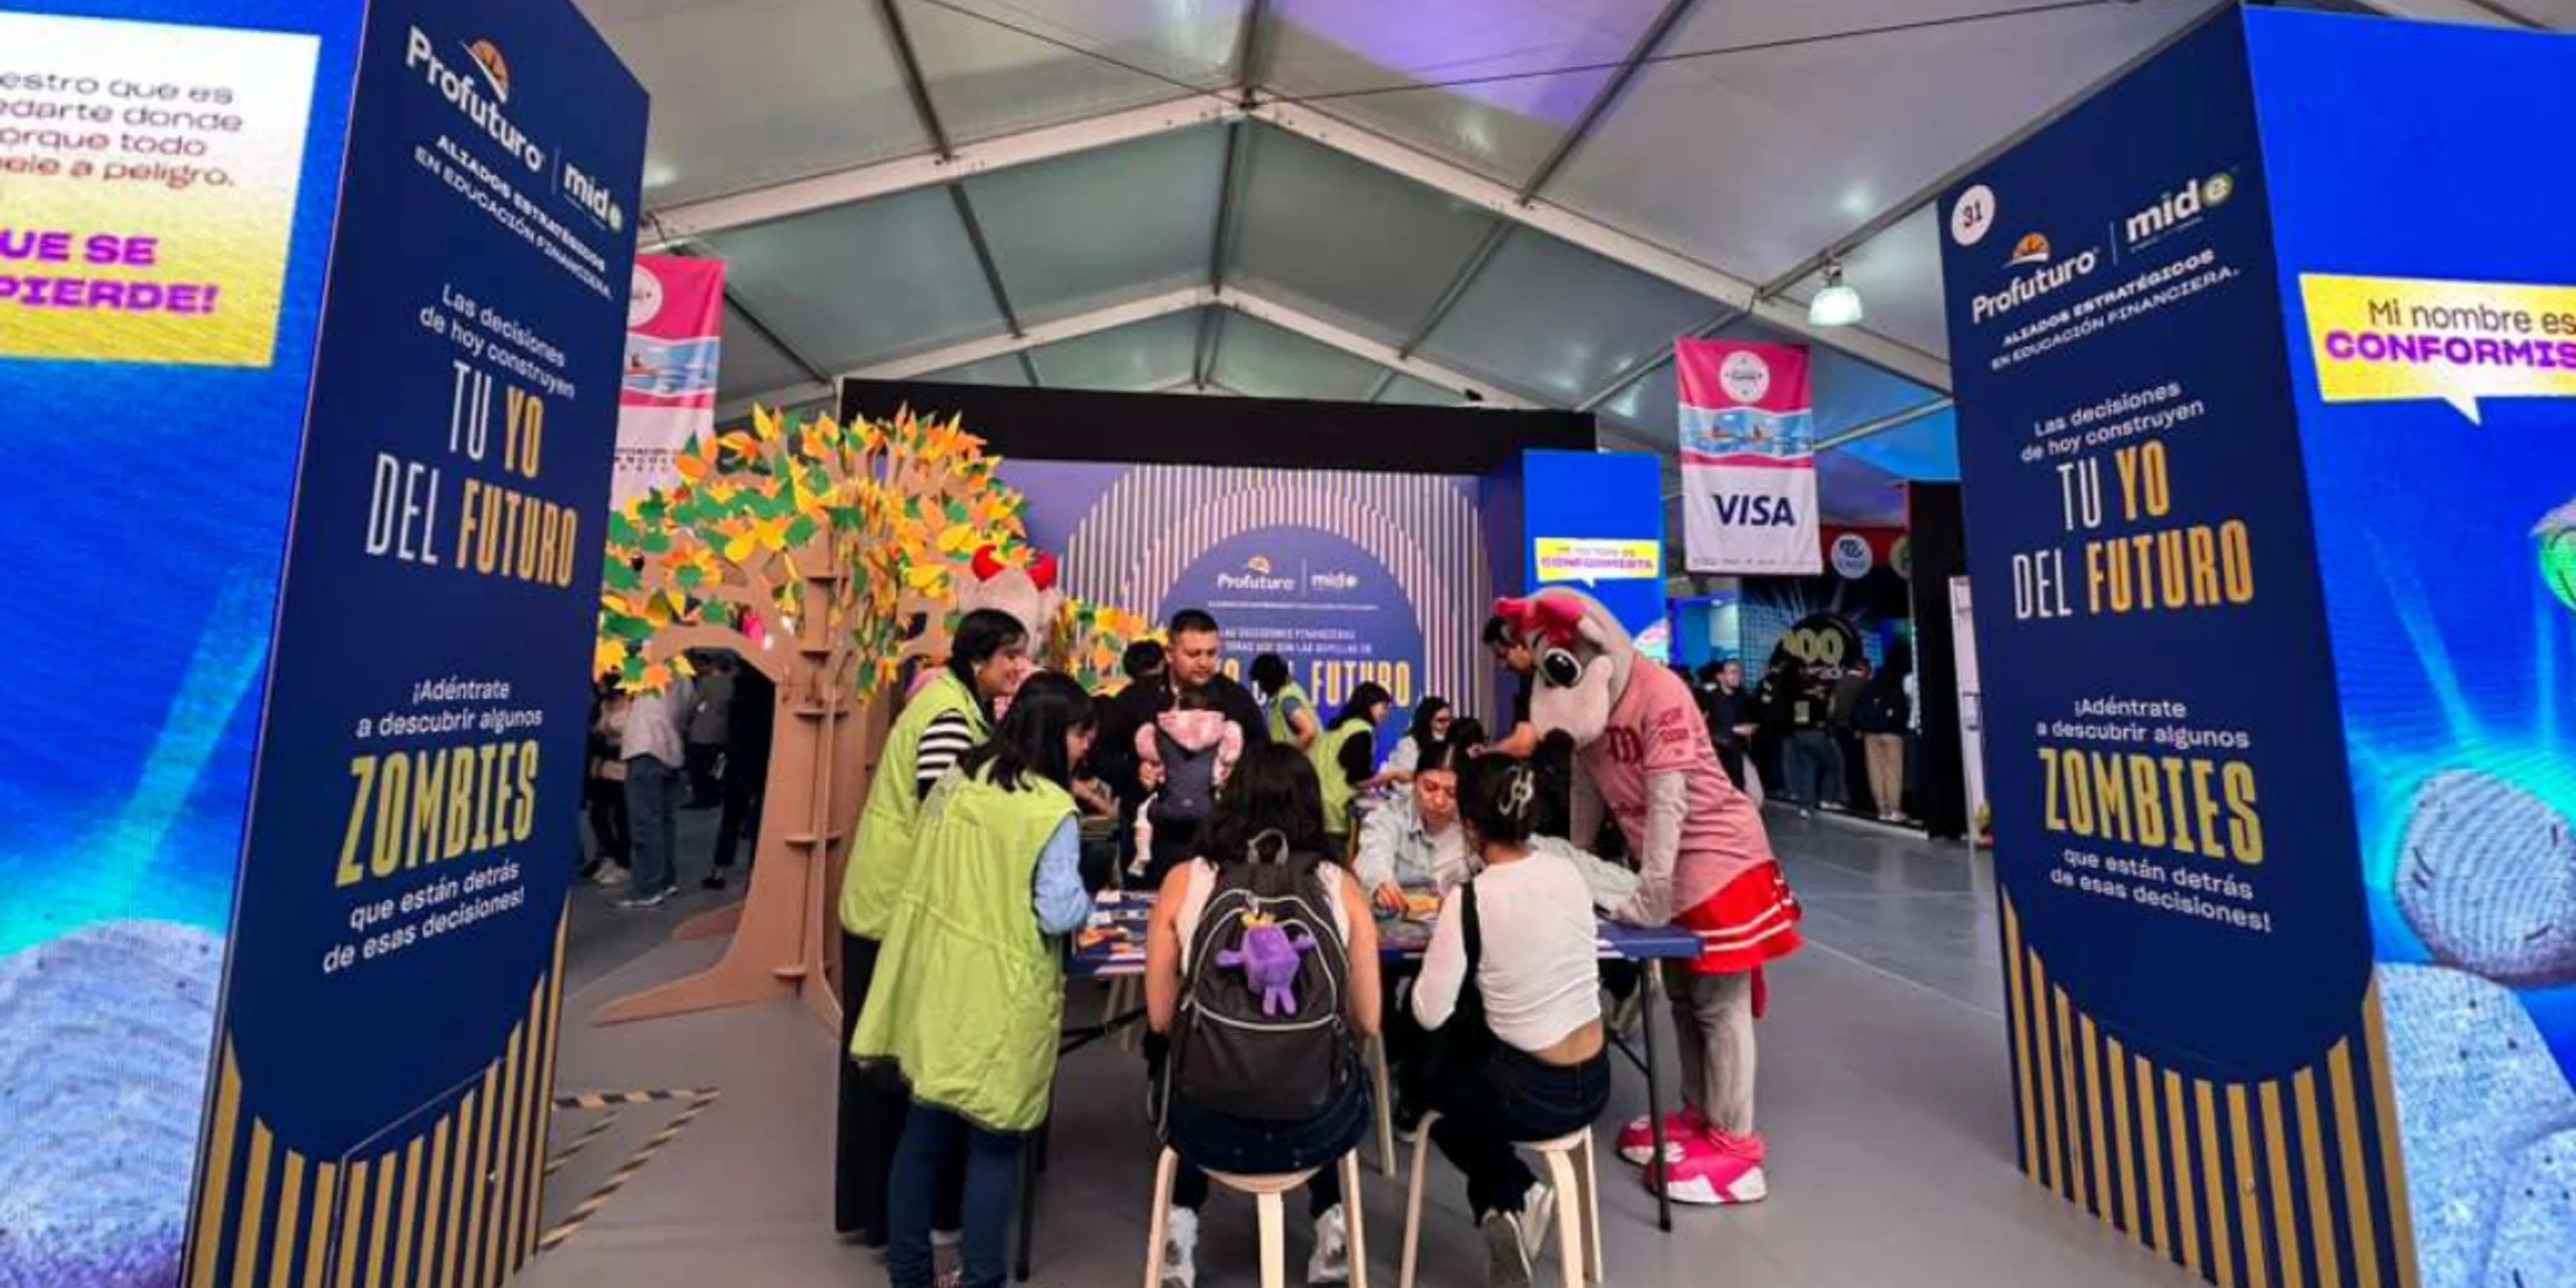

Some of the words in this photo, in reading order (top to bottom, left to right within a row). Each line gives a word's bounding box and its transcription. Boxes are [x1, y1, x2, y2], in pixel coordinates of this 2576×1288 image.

[109, 78, 179, 99] que
[188, 86, 233, 105] es
[123, 105, 242, 131] donde
[121, 133, 207, 156] todo
[406, 25, 545, 172] Profuturo
[564, 162, 623, 232] mide
[414, 145, 441, 174] EN
[70, 159, 93, 178] a
[103, 162, 235, 191] peligro.
[1963, 201, 1983, 228] 31
[85, 235, 158, 266] SE
[1972, 250, 2097, 325] Profuturo
[2127, 172, 2235, 243] mide
[442, 284, 476, 318] Las
[480, 305, 566, 368] decisiones
[1991, 356, 2011, 370] EN
[2012, 317, 2105, 362] EDUCACIÓN
[2106, 267, 2239, 325] FINANCIERA.
[2002, 311, 2071, 347] ALIADOS
[2073, 248, 2216, 317] ESTRATÉGICOS
[2368, 299, 2403, 327] Mi
[2411, 305, 2533, 334] nombre
[2541, 312, 2576, 336] es
[420, 307, 446, 335] de
[450, 321, 484, 356] hoy
[486, 335, 576, 399] construyen
[449, 360, 492, 462] TU
[504, 385, 545, 478] YO
[2021, 445, 2044, 463] de
[2048, 433, 2082, 457] hoy
[2084, 399, 2205, 445] construyen
[2034, 421, 2066, 437] Las
[2070, 381, 2182, 427] decisiones
[1713, 494, 1797, 527] VISA
[2056, 457, 2102, 531] TU
[2115, 439, 2171, 521] YO
[365, 452, 440, 565] DEL
[455, 478, 579, 589] FUTURO
[2012, 547, 2073, 620] DEL
[2086, 519, 2255, 614] FUTURO
[412, 673, 510, 704] ¡Adéntrate
[2074, 696, 2187, 718] ¡Adéntrate
[356, 716, 372, 738] a
[379, 709, 476, 737] descubrir
[480, 708, 543, 735] algunos
[2037, 723, 2047, 736] a
[2052, 720, 2147, 741] descubrir
[2153, 727, 2251, 749] algunos
[335, 739, 539, 889] ZOMBIES
[2037, 746, 2265, 865] ZOMBIES
[349, 896, 395, 932] que
[400, 876, 459, 914] están
[463, 859, 520, 894] detrás
[2050, 870, 2074, 886] de
[2080, 875, 2127, 899] esas
[2133, 887, 2273, 933] decisiones!
[2063, 848, 2100, 866] que
[2105, 858, 2167, 883] están
[2172, 867, 2254, 900] detrás
[323, 944, 355, 973] de
[362, 927, 416, 959] esas
[421, 886, 525, 938] decisiones!
